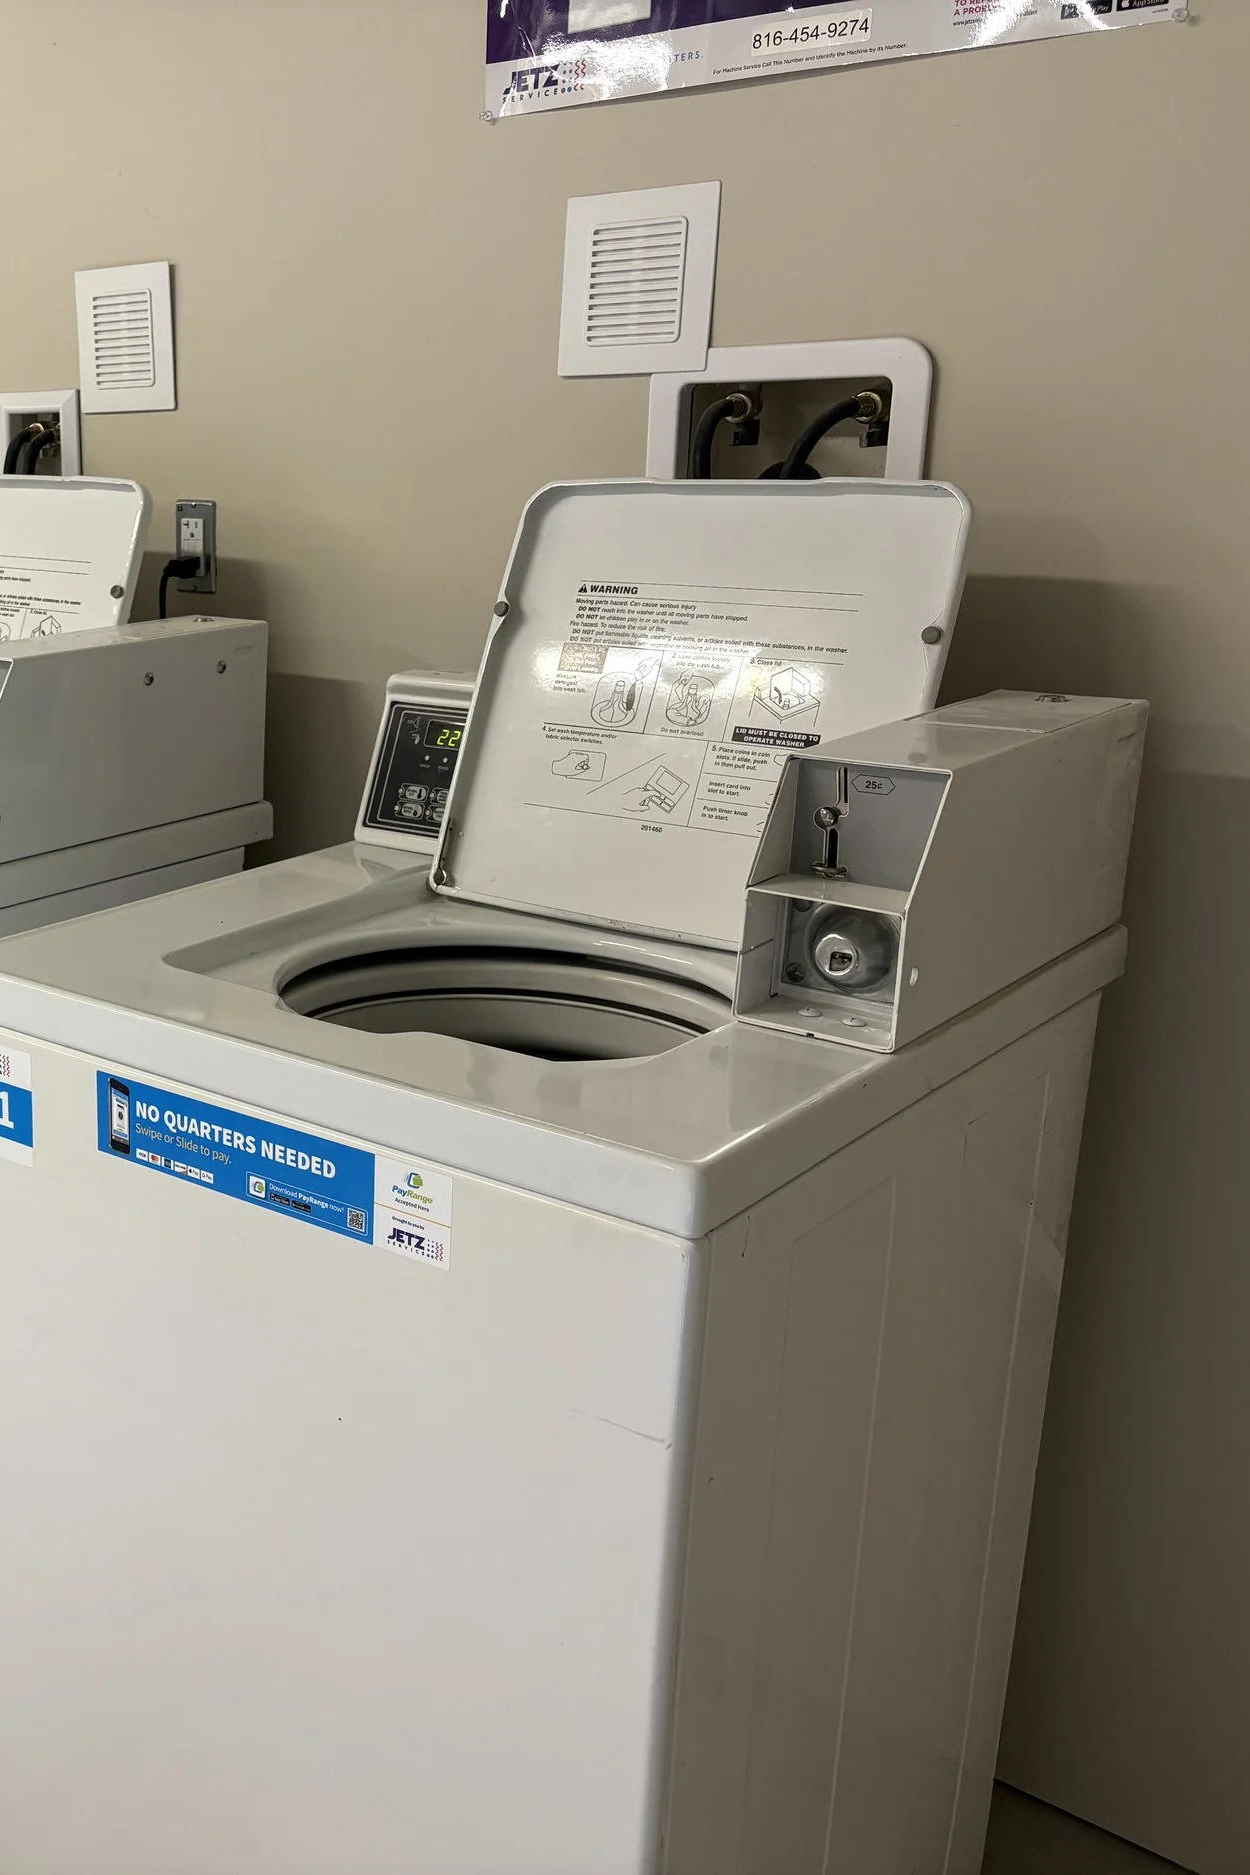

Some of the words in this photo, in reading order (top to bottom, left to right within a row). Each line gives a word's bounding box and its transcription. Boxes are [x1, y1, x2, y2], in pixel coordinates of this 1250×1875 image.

[752, 17, 869, 49] 816-454-9274
[784, 57, 805, 65] Number
[816, 53, 836, 61] Identify
[885, 42, 908, 51] Number.
[503, 63, 560, 95] JETZ
[502, 89, 558, 104] SERVICE
[590, 585, 638, 594] WARNING
[436, 729, 461, 746] 22
[570, 729, 600, 738] temperature
[680, 729, 704, 737] overload.
[748, 728, 767, 736] MUST
[780, 732, 808, 740] CLOSED
[744, 736, 775, 744] OPERATE
[718, 746, 734, 754] Place
[735, 748, 750, 756] coins
[737, 756, 753, 764] slide,
[709, 780, 726, 789] Insert
[865, 780, 883, 790] 25¢
[734, 809, 748, 817] knob
[641, 825, 662, 833] 201460
[135, 1101, 160, 1123] NO
[164, 1110, 256, 1154] QUARTERS
[261, 1140, 336, 1179] NEEDED
[135, 1122, 162, 1141] Swipe
[164, 1133, 174, 1144] or
[176, 1136, 198, 1152] Slide
[200, 1145, 210, 1156] to
[212, 1150, 232, 1165] pay.
[269, 1183, 297, 1198] Download
[298, 1193, 329, 1209] PayRange
[329, 1205, 345, 1213] now!
[391, 1185, 433, 1204] PayRange
[394, 1197, 417, 1209] Accepted
[418, 1204, 430, 1213] Here
[392, 1215, 407, 1225] Brought
[387, 1227, 425, 1251] JETZ
[387, 1239, 425, 1256] SERVICE
